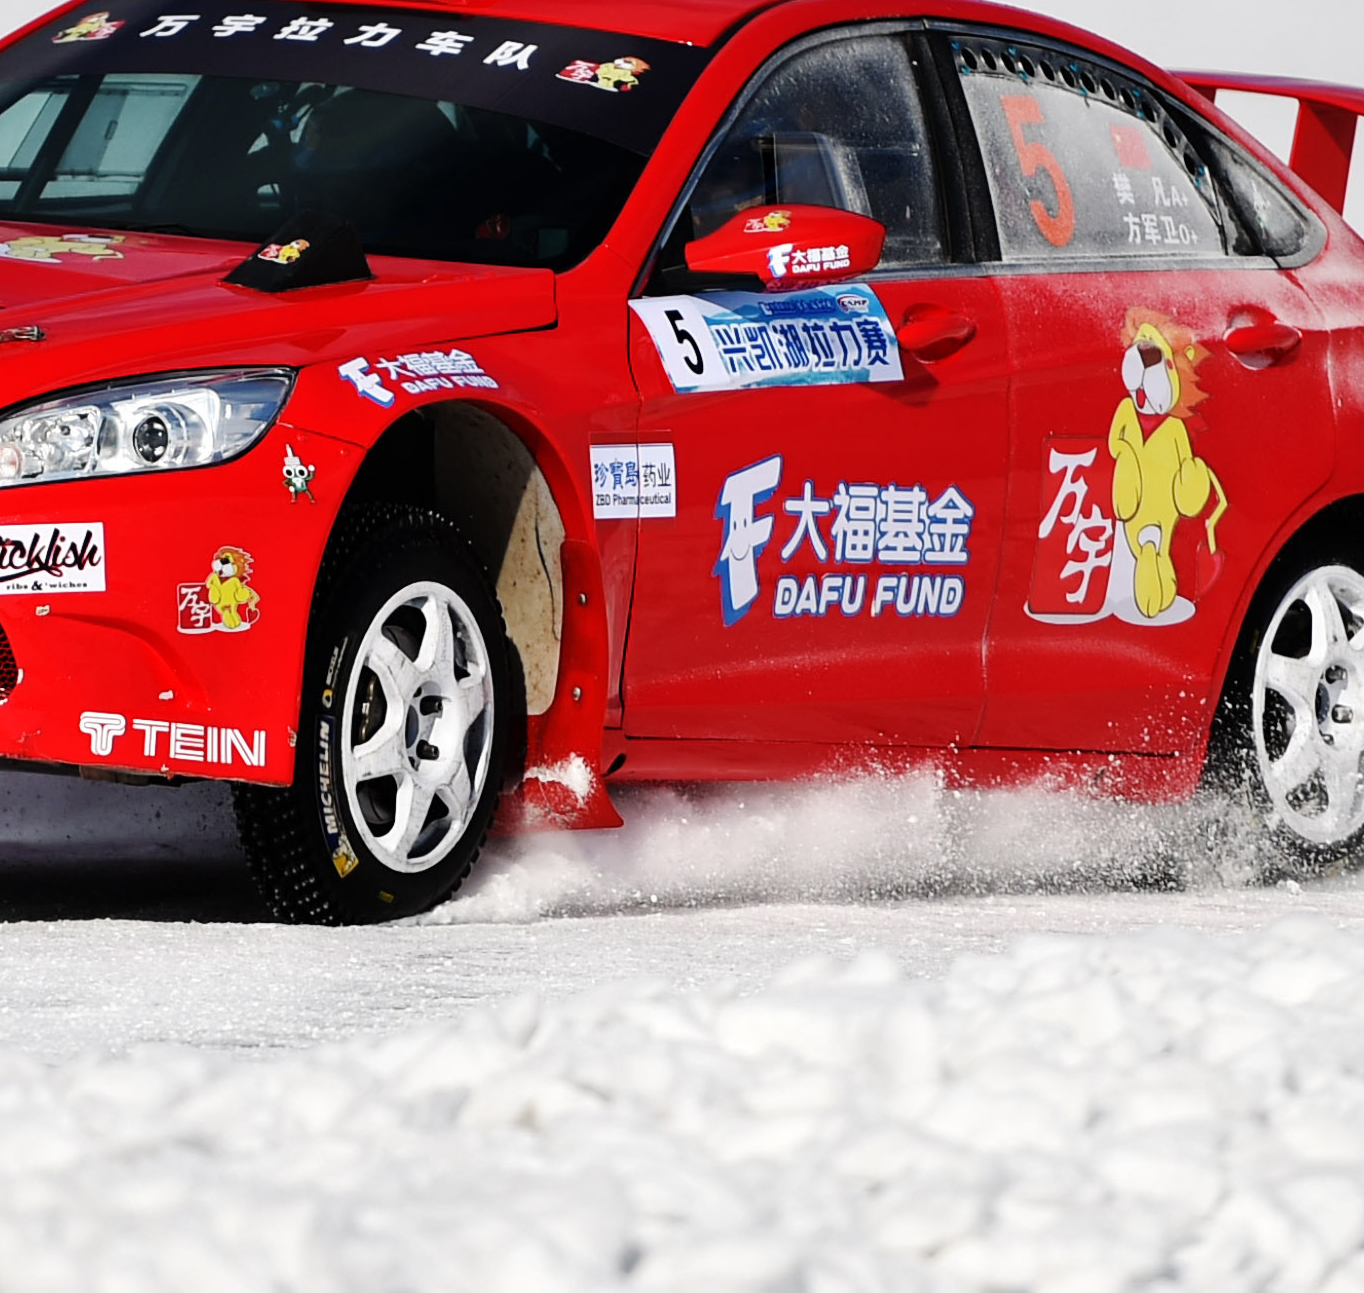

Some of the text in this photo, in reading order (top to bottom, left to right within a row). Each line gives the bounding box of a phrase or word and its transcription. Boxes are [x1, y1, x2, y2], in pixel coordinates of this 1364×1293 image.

[139, 14, 538, 70] 万宇拉力车队
[1000, 94, 1076, 247] 5
[791, 245, 849, 264] 大福基金
[792, 259, 850, 274] DAFU FUND
[374, 348, 486, 381] 大福基金
[664, 309, 704, 375] 5
[715, 318, 890, 373] 兴凯湖拉力赛
[401, 374, 499, 394] DAFU FUND
[596, 492, 671, 506] ZBD Pharmaceutical
[781, 478, 976, 564] 大福基金
[1038, 447, 1113, 603] 万宇
[6, 581, 29, 590] ribs
[31, 580, 43, 591] &
[179, 586, 212, 627] 万宇
[773, 575, 965, 618] DAFU FUND
[132, 718, 266, 767] TEIN
[318, 720, 339, 835] MICHELIN
